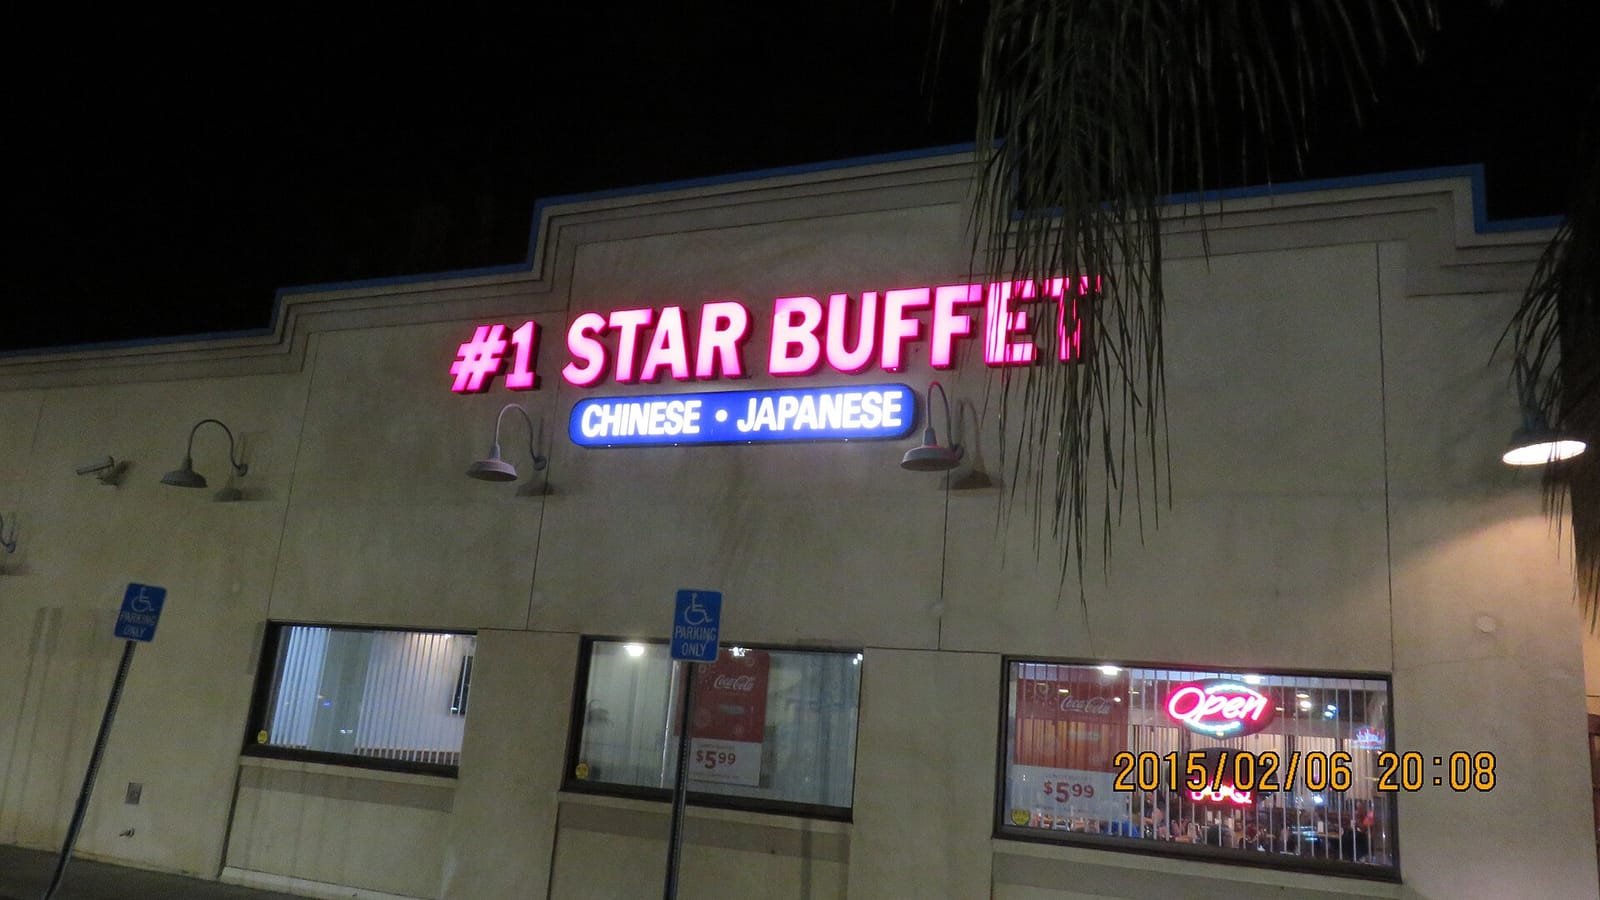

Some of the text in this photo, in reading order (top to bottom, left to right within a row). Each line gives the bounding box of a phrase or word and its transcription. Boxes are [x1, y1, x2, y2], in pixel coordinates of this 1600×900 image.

[450, 275, 1101, 392] #1 STAR BUFFET
[581, 390, 903, 438] CHINESE JAPANESE
[674, 625, 717, 641] PARKING
[681, 640, 711, 657] ONLY
[1168, 685, 1268, 724] Open
